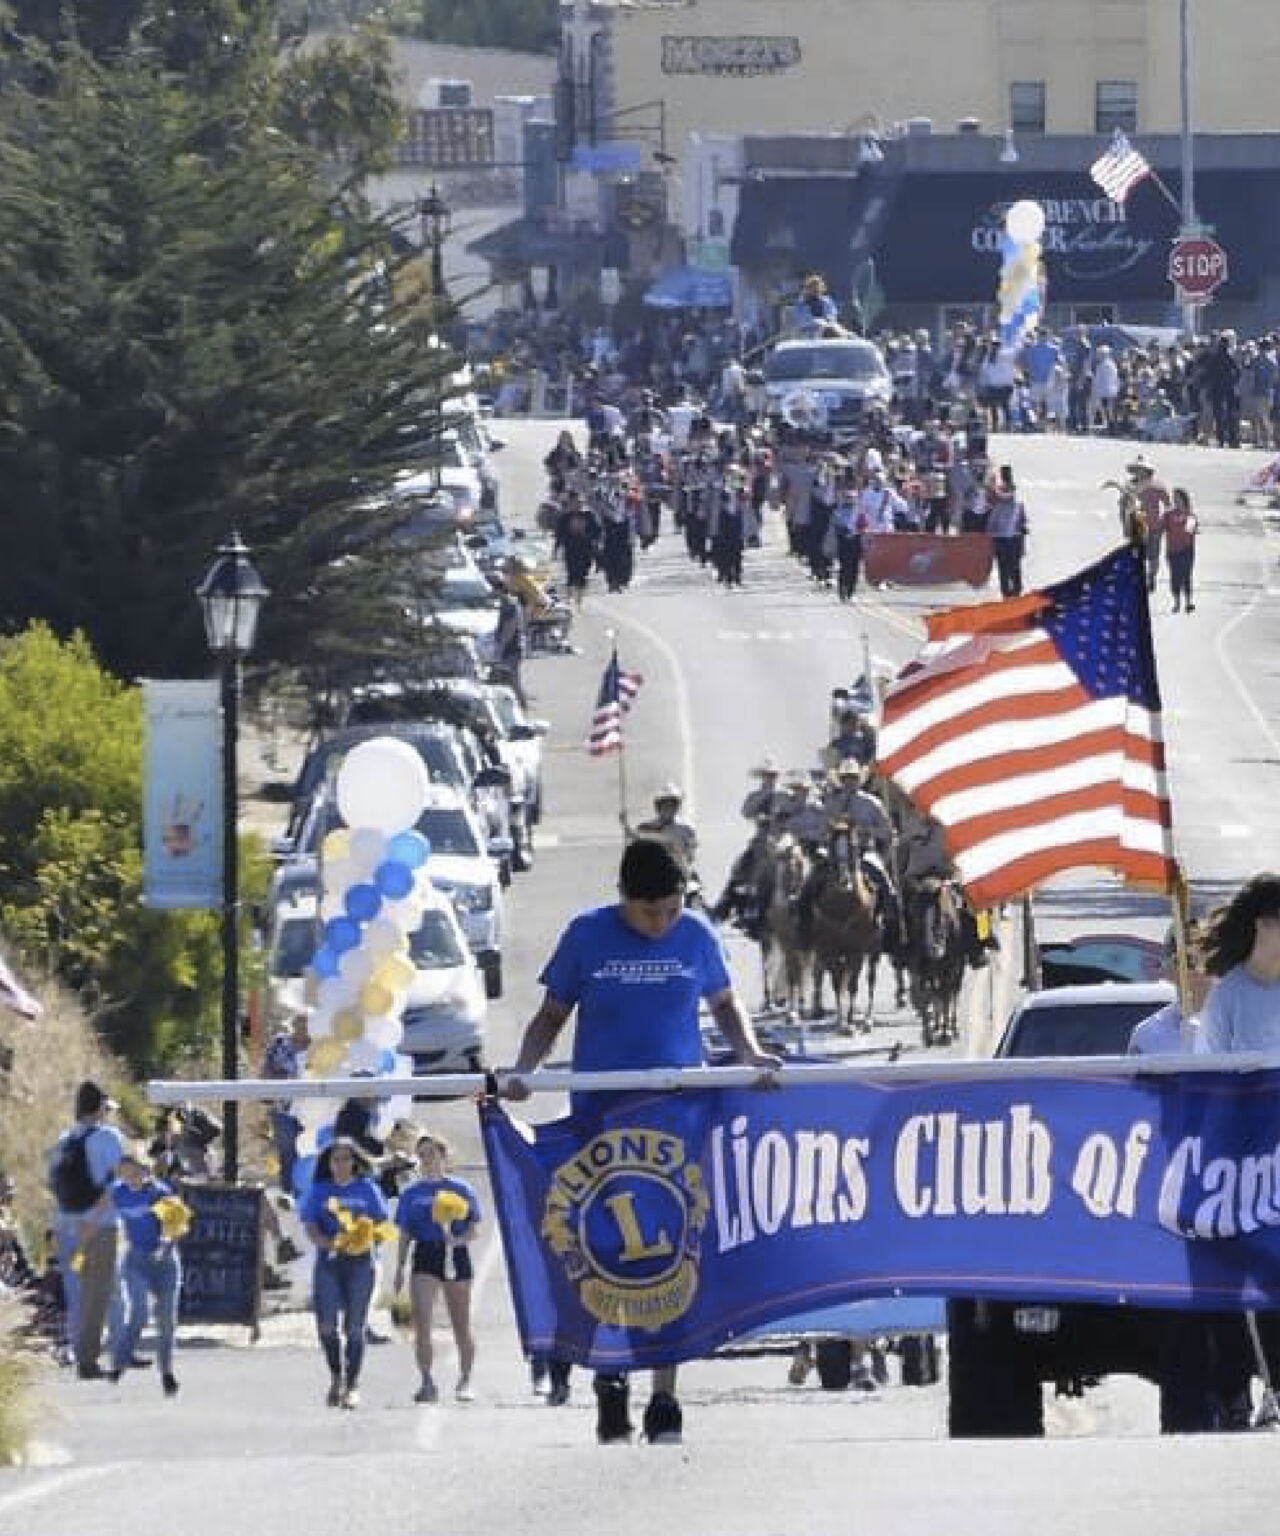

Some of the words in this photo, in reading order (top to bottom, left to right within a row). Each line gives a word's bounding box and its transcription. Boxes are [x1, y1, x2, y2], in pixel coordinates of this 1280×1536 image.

[1044, 198, 1126, 223] RENCH
[1173, 253, 1222, 277] STOP
[556, 1135, 677, 1193] LIONS
[711, 1115, 870, 1254] Lions
[895, 1103, 1053, 1218] Club
[1072, 1119, 1152, 1218] of
[603, 1192, 674, 1263] L
